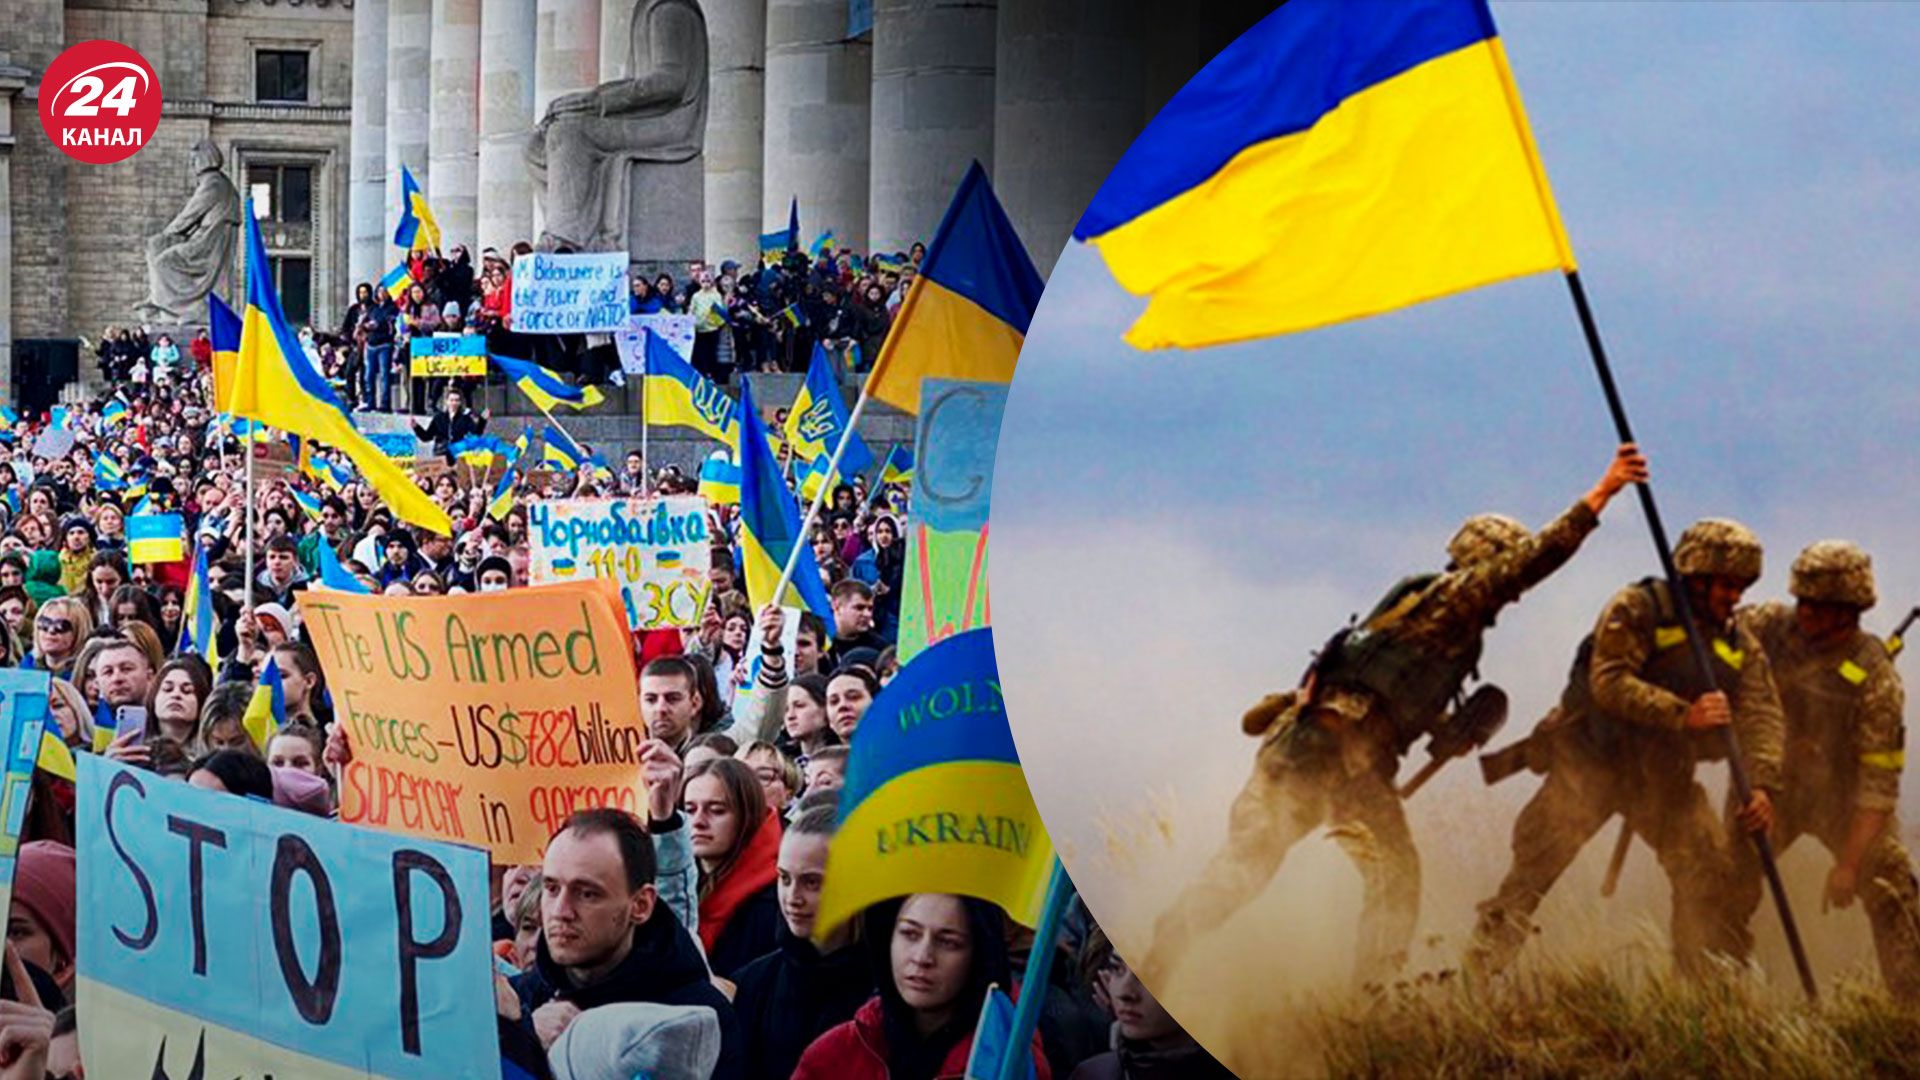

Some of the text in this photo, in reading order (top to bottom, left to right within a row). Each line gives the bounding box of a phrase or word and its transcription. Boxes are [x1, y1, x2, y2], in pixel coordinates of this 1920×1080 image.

[530, 501, 709, 558] Чорнобаївка
[643, 580, 713, 628] ЗСУ
[301, 602, 373, 674] The
[376, 611, 431, 681] US
[445, 601, 601, 683] Armed
[479, 793, 514, 843] in
[104, 769, 463, 1056] STOP
